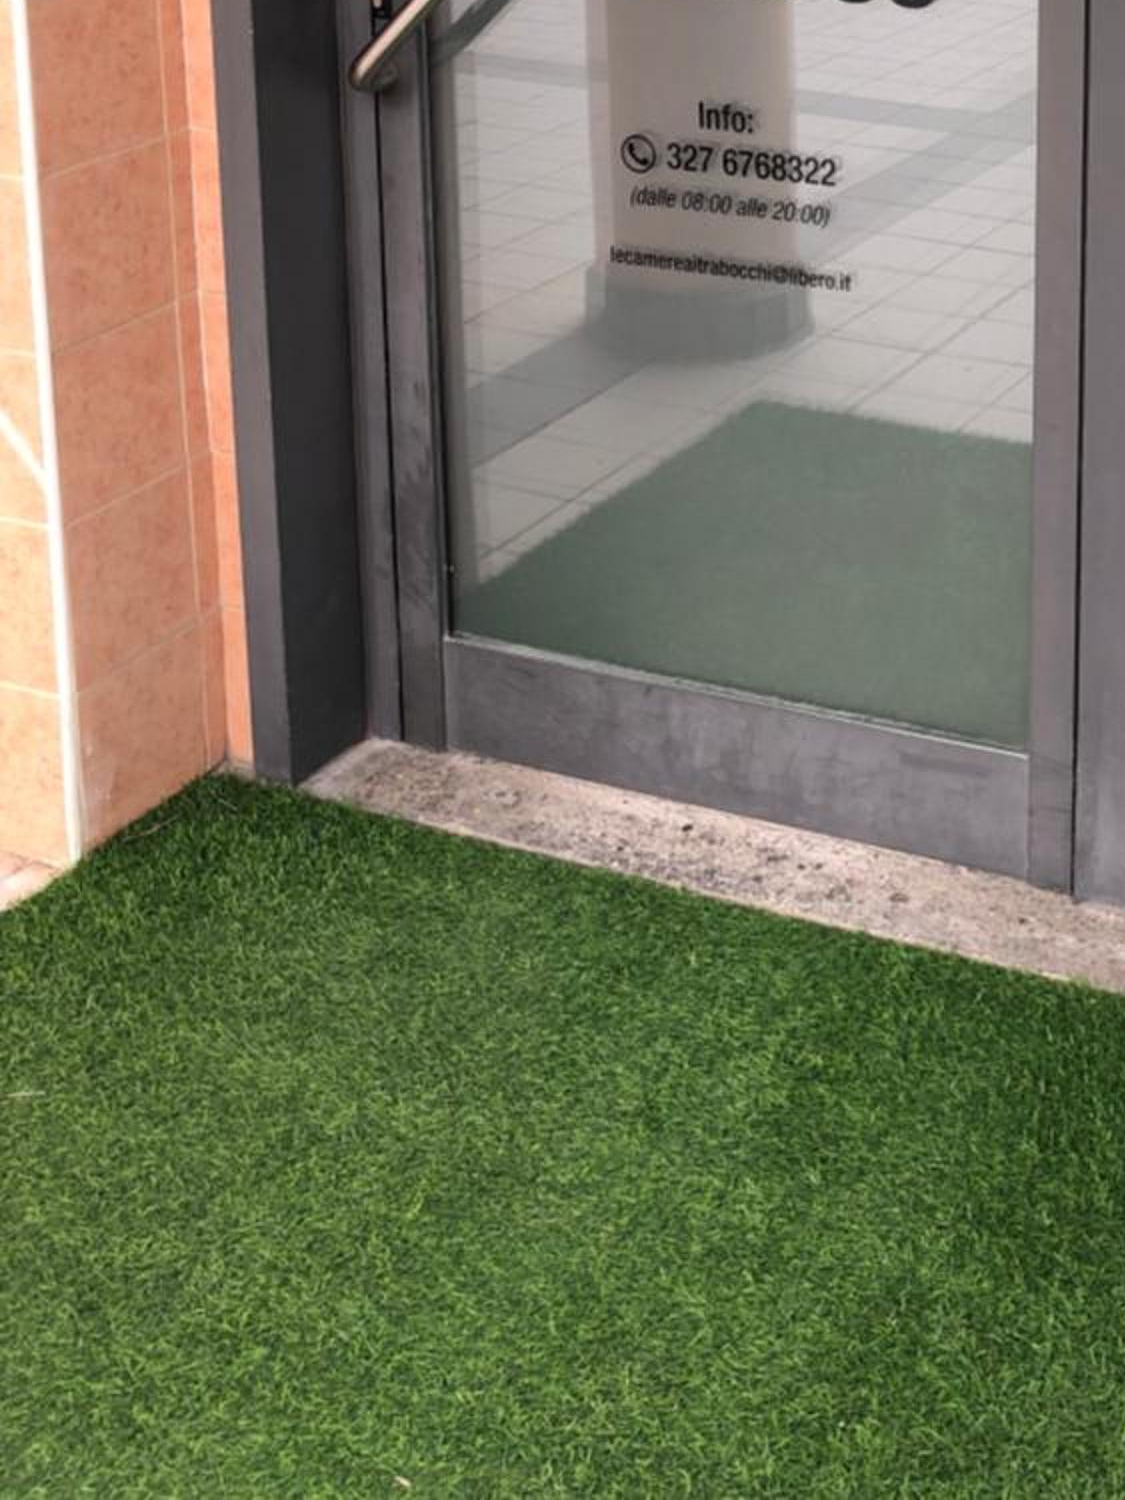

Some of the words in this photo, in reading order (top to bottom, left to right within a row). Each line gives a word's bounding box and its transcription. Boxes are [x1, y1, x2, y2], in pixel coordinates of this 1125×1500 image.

[698, 101, 755, 134] Info:
[666, 142, 713, 173] 327
[722, 148, 837, 187] 6768322
[629, 185, 677, 209] (dalle
[680, 191, 732, 215] 08:00
[735, 198, 768, 219] alle
[771, 202, 832, 229] 20:00)
